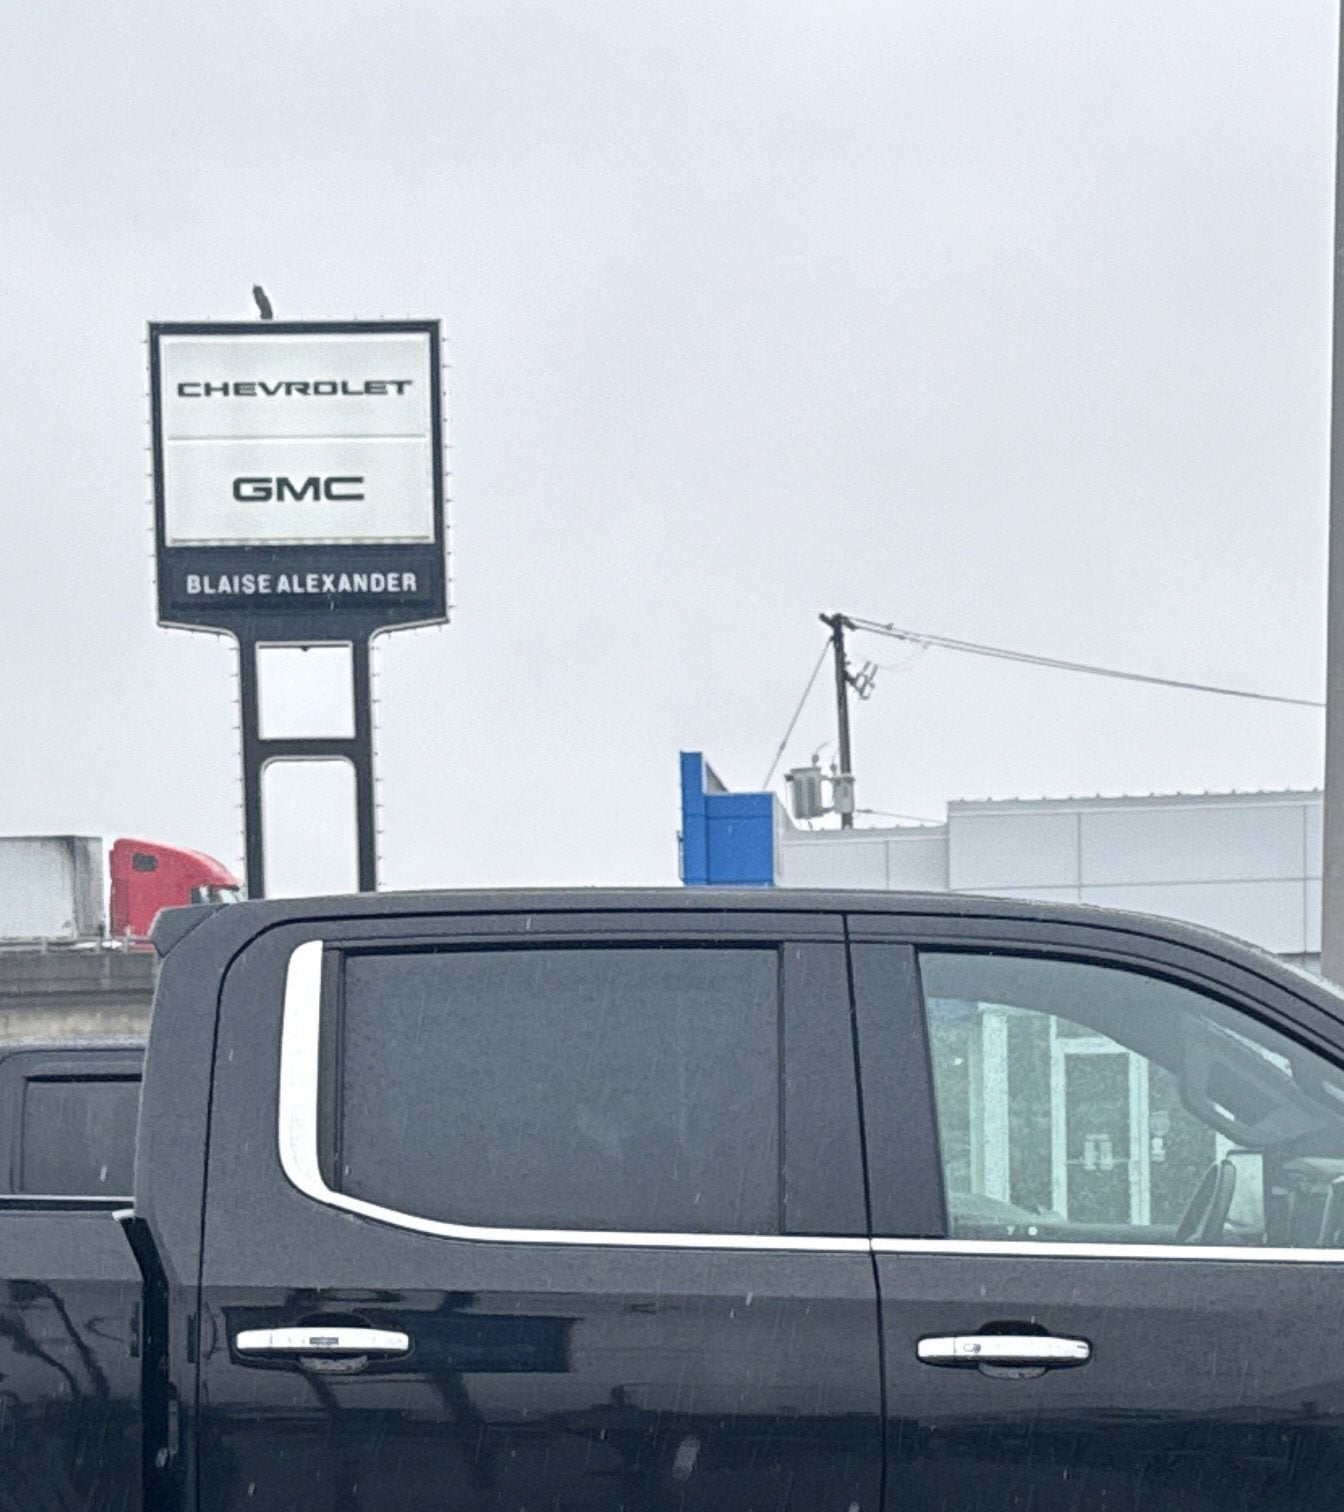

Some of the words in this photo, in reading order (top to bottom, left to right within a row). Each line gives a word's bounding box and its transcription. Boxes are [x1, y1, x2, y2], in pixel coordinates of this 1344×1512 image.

[177, 380, 412, 396] CHEVROLET
[232, 476, 365, 501] GMC
[186, 573, 271, 595] BLAISE
[276, 572, 417, 594] ALEXANDER
